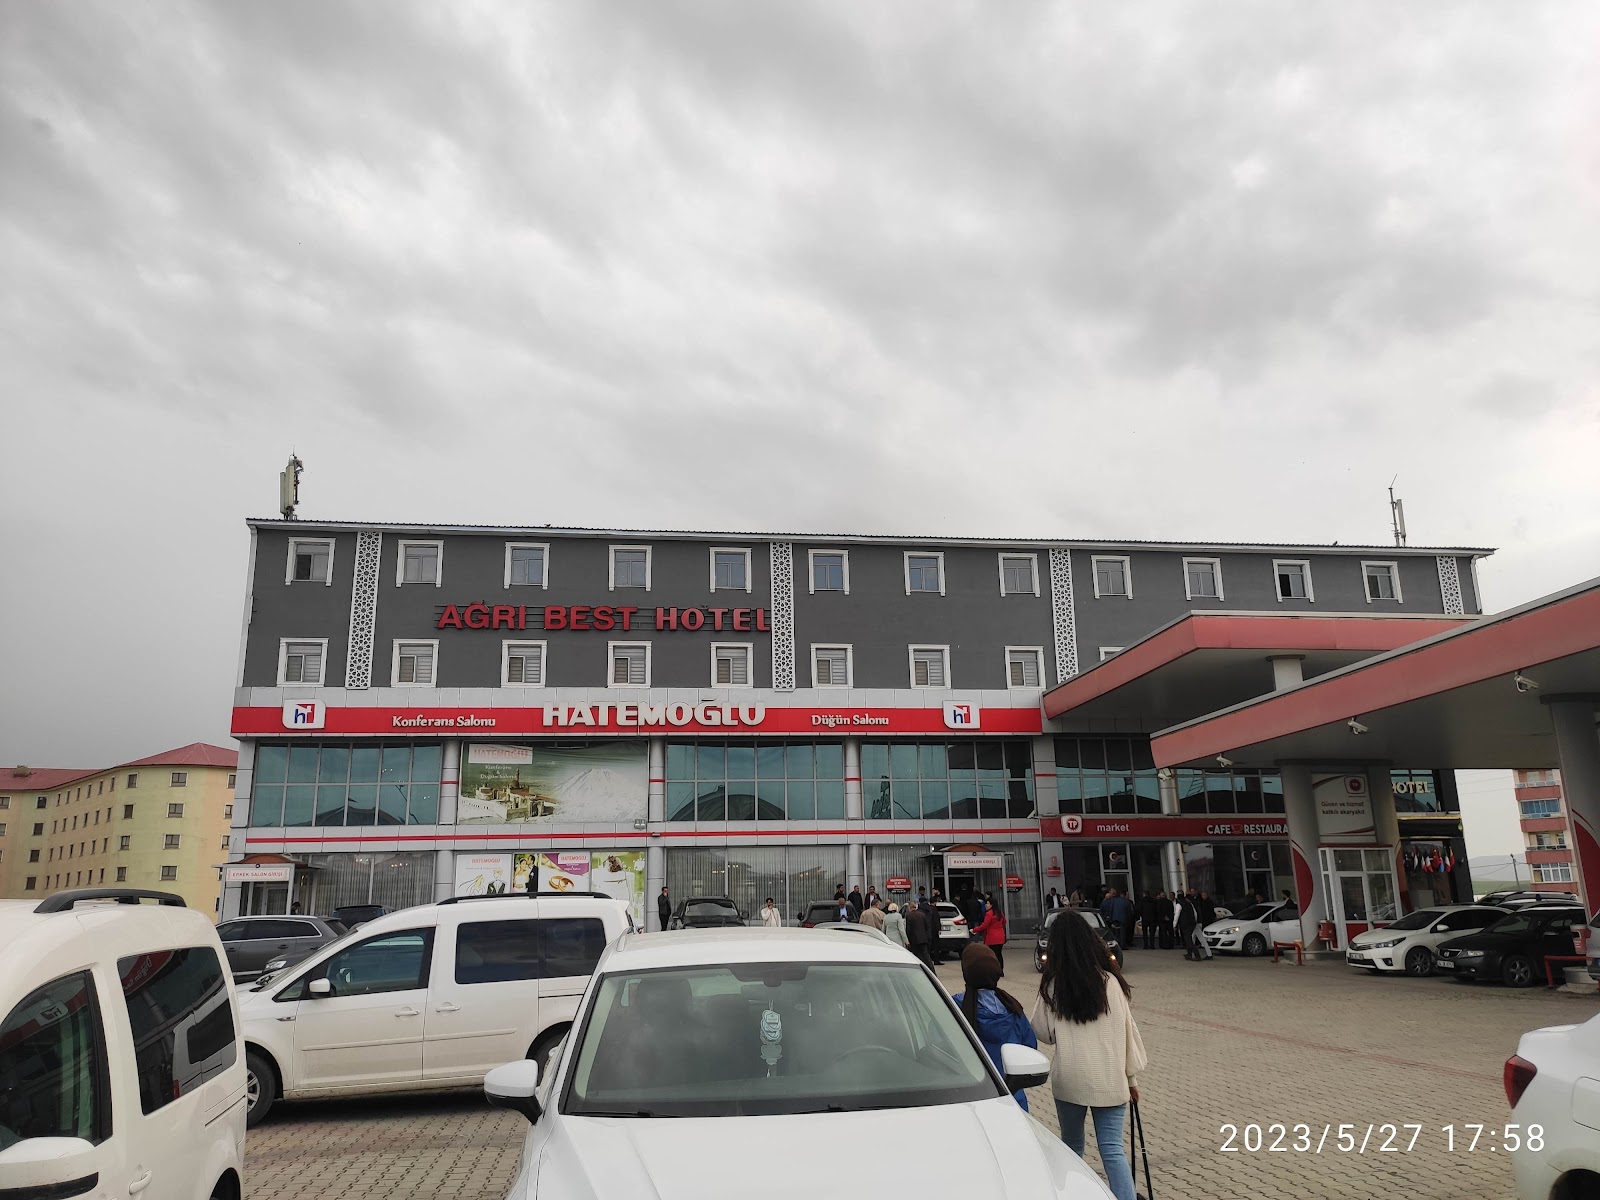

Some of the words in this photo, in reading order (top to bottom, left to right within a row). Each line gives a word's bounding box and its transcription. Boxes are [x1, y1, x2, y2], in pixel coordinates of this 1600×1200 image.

[438, 602, 526, 630] AĞRI
[544, 605, 638, 631] BEST
[656, 607, 770, 631] HOTEL
[543, 697, 766, 727] HATEMOĞLU
[392, 714, 454, 727] Konferans
[457, 714, 496, 727] Salonu
[811, 714, 851, 728] Düğün
[853, 713, 889, 726] Salonu
[1067, 820, 1078, 829] TP
[1096, 823, 1129, 833] market
[1206, 824, 1231, 834] CAFE
